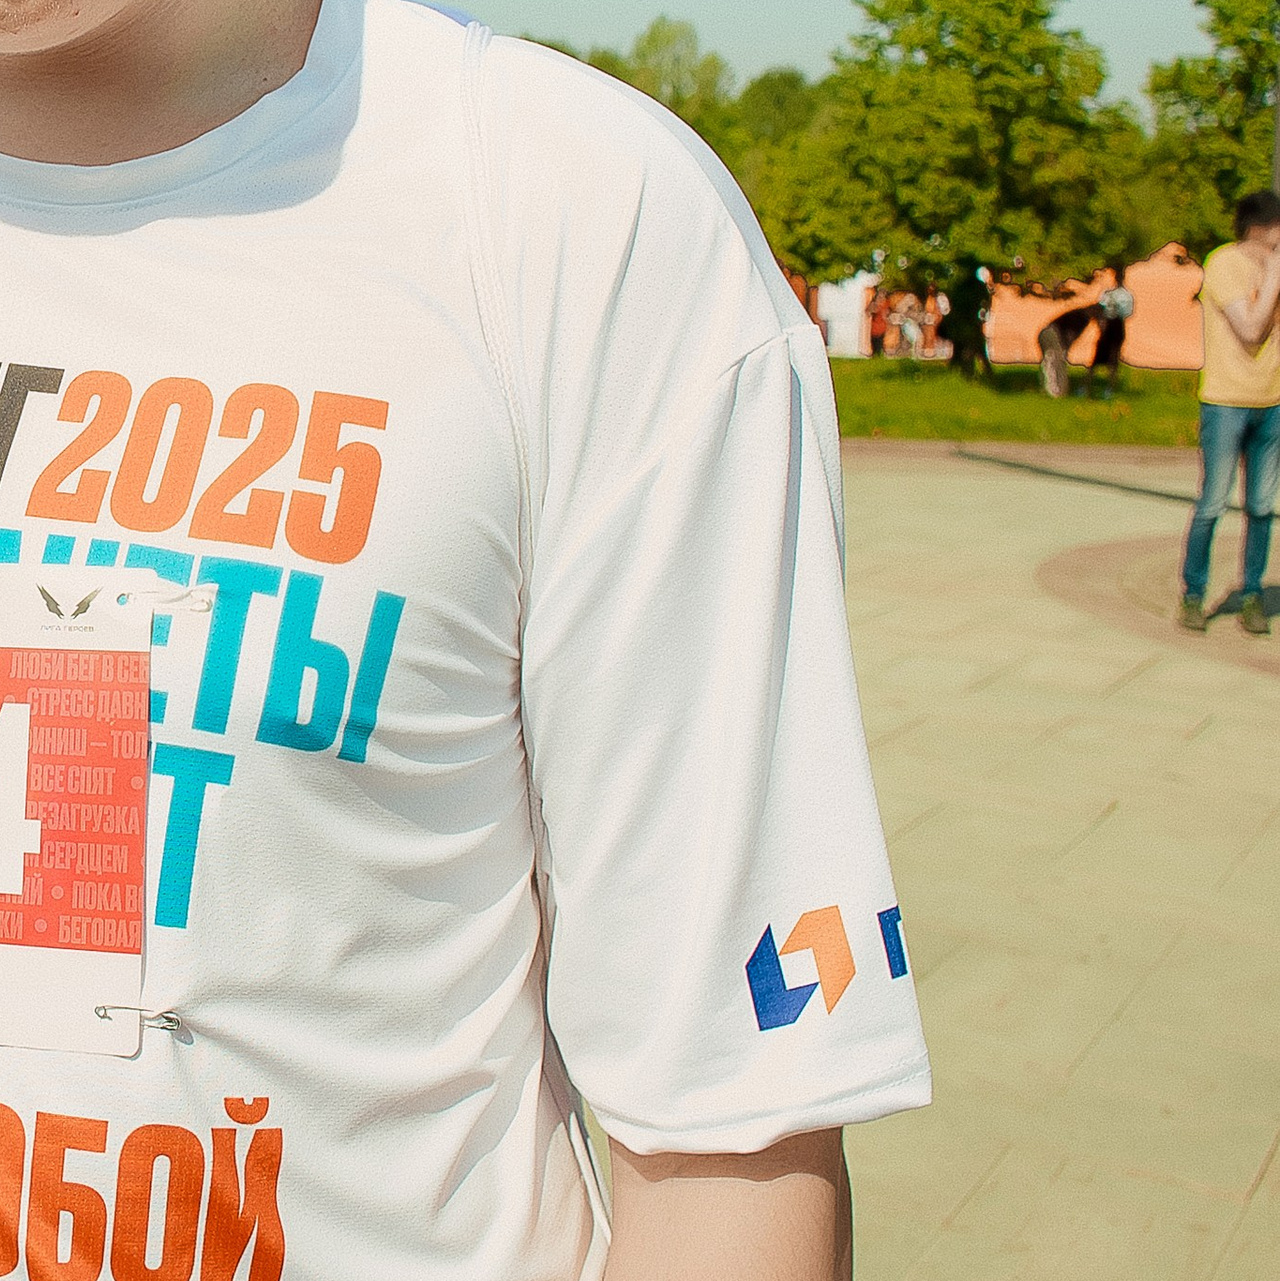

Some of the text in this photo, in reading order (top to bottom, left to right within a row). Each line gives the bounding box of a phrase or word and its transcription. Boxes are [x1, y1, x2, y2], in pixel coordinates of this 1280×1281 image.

[10, 651, 65, 681] ЛЮБИ
[66, 653, 100, 682] БЕГ
[101, 655, 115, 683] В
[27, 687, 96, 718] СТРЕСС
[28, 726, 87, 756] ИНИШ
[31, 763, 116, 795] ВСЕ СПЯТ
[43, 841, 129, 875] СЕРДЦЕМ
[72, 880, 122, 912] ПОКА
[59, 915, 142, 948] БЕГОВАЯ
